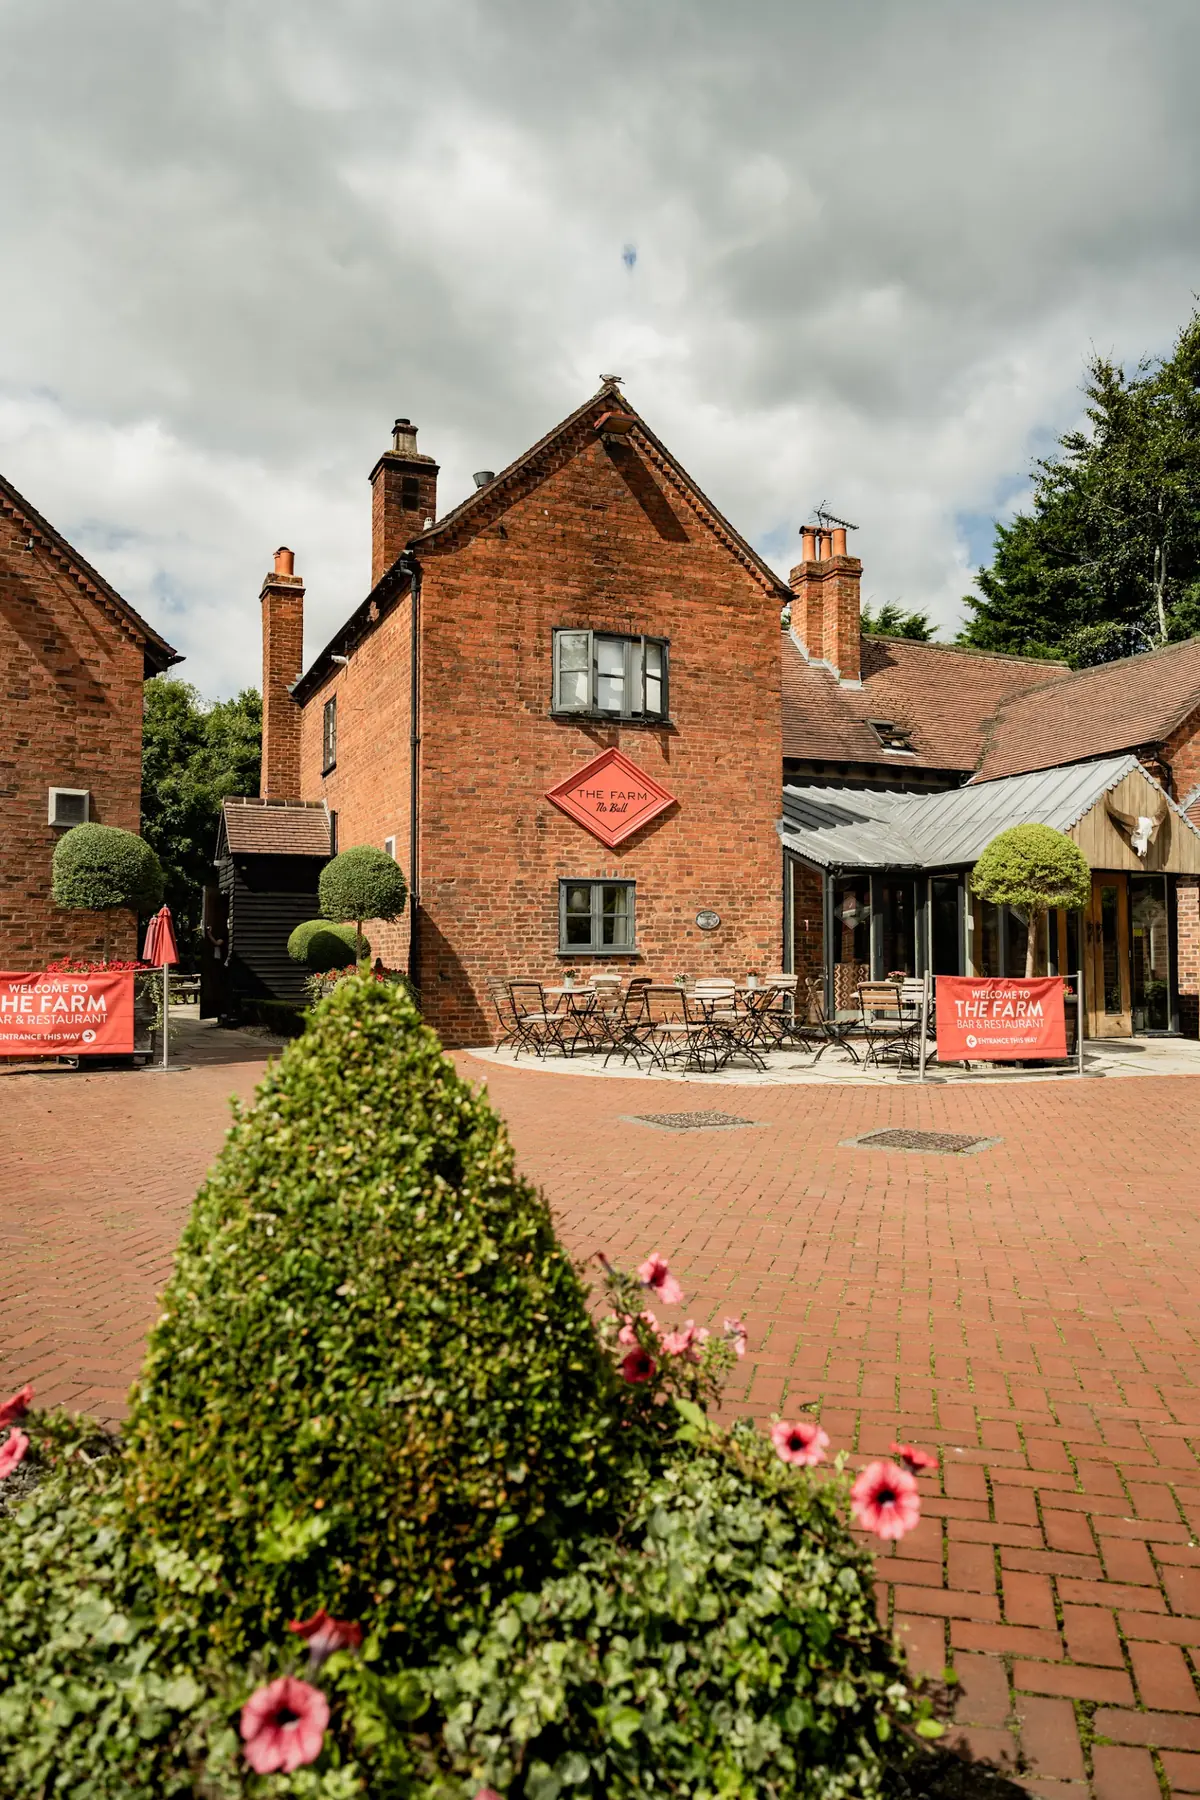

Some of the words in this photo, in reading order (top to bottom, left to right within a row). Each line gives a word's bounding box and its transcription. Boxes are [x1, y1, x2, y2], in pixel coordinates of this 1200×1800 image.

[577, 789, 604, 799] THE
[610, 791, 648, 801] FARM
[596, 802, 607, 812] No
[609, 802, 628, 812] Bull
[8, 984, 69, 994] WELCOME
[72, 984, 88, 993] TO
[972, 990, 1016, 999] WELCOME
[1018, 990, 1030, 999] TO
[0, 995, 33, 1012] HE
[40, 994, 107, 1012] FARM
[955, 1000, 988, 1018] THE
[992, 1000, 1044, 1018] FARM
[16, 1014, 24, 1024] &
[28, 1014, 108, 1024] RESTAURANT
[957, 1020, 974, 1028] BAR
[976, 1020, 982, 1028] &
[984, 1018, 1044, 1028] RESTAURANT
